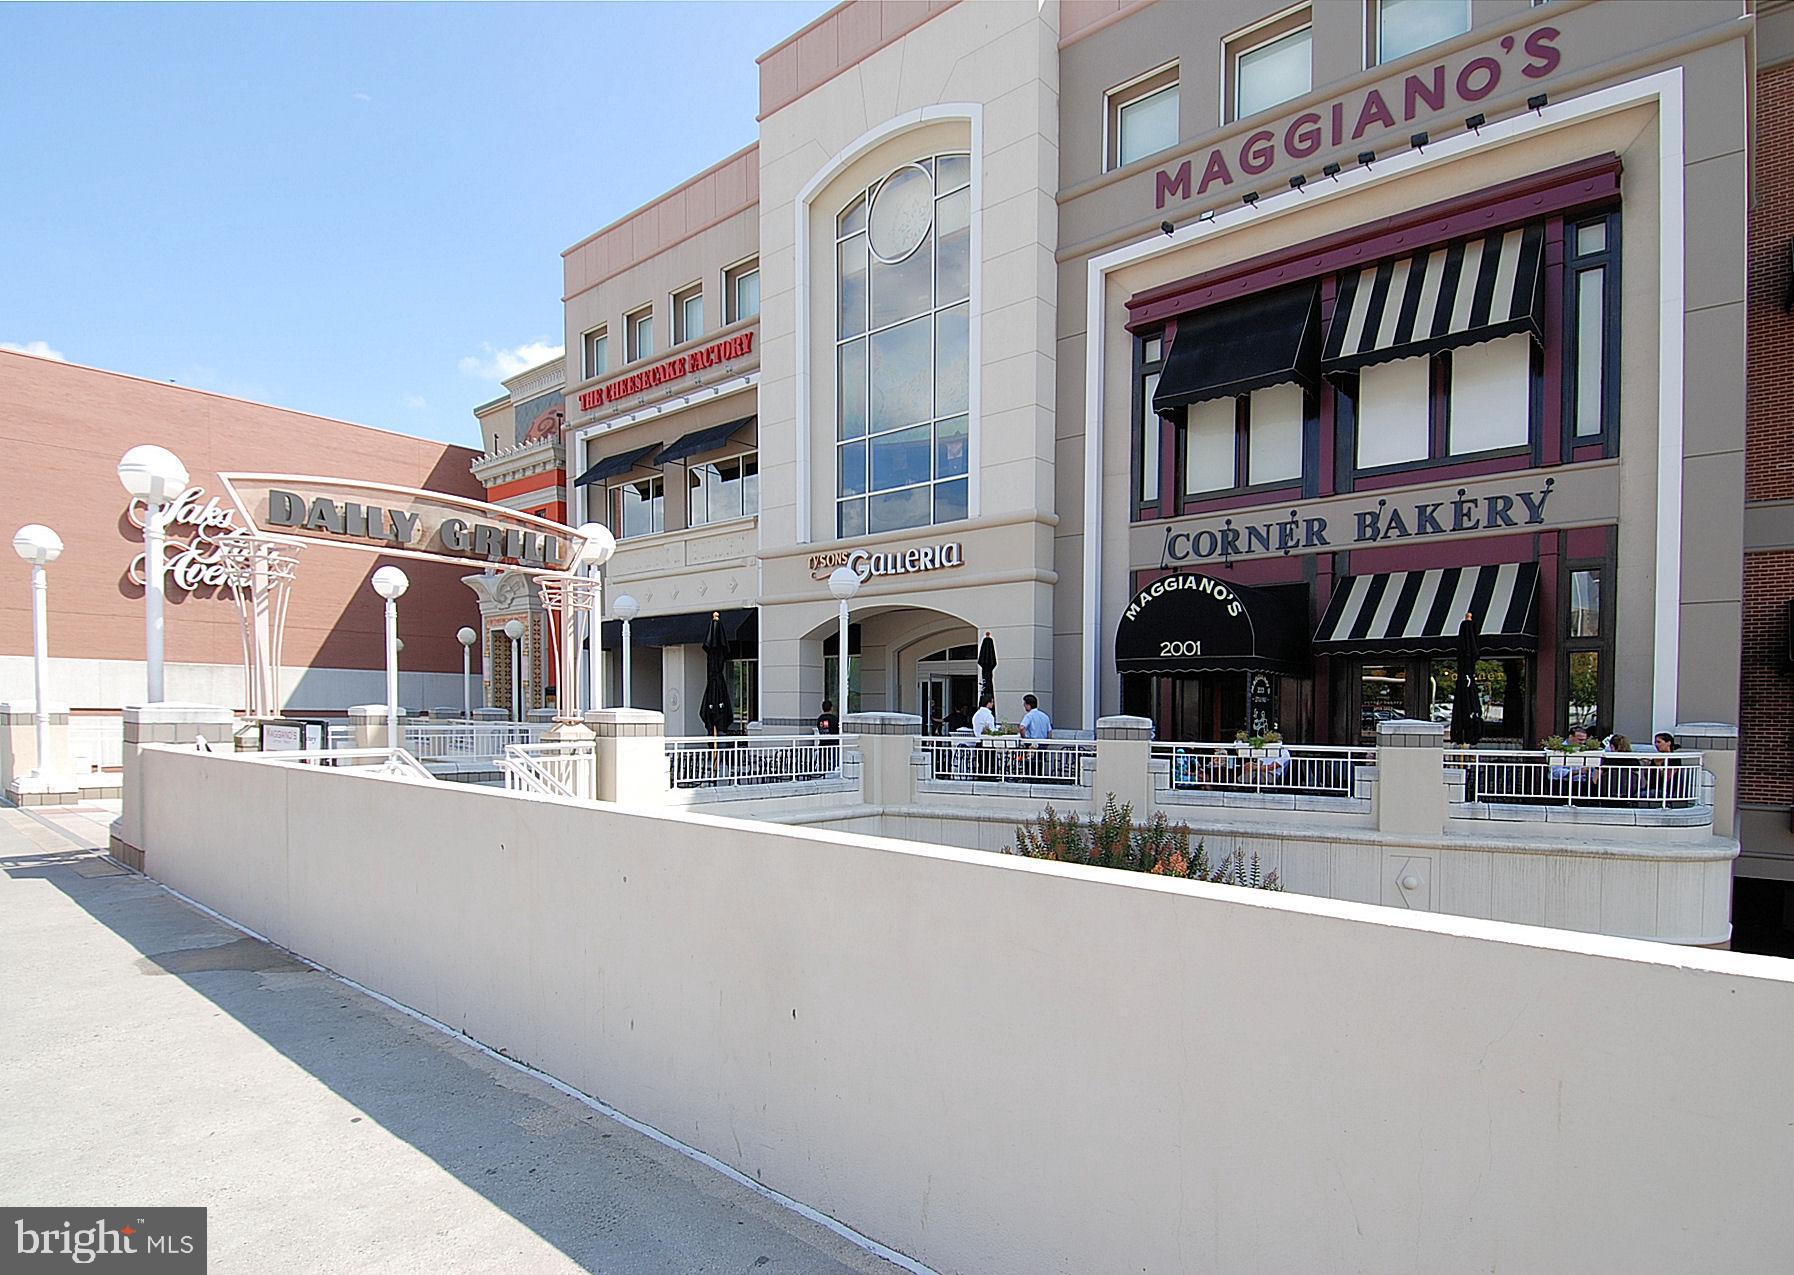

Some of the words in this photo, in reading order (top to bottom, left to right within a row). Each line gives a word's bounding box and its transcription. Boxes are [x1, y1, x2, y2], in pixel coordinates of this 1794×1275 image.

[1155, 26, 1562, 210] MAGGIANO'S
[578, 387, 604, 412] THE
[605, 357, 687, 403] CHEESECAKE
[687, 331, 754, 373] FACTORY
[268, 489, 420, 544] DAILY
[440, 518, 564, 563] GRILL
[1165, 516, 1331, 561] CORNER
[1353, 488, 1555, 543] BAKERY
[1125, 575, 1243, 622] MAGGIANO'S
[1160, 640, 1201, 657] 2001
